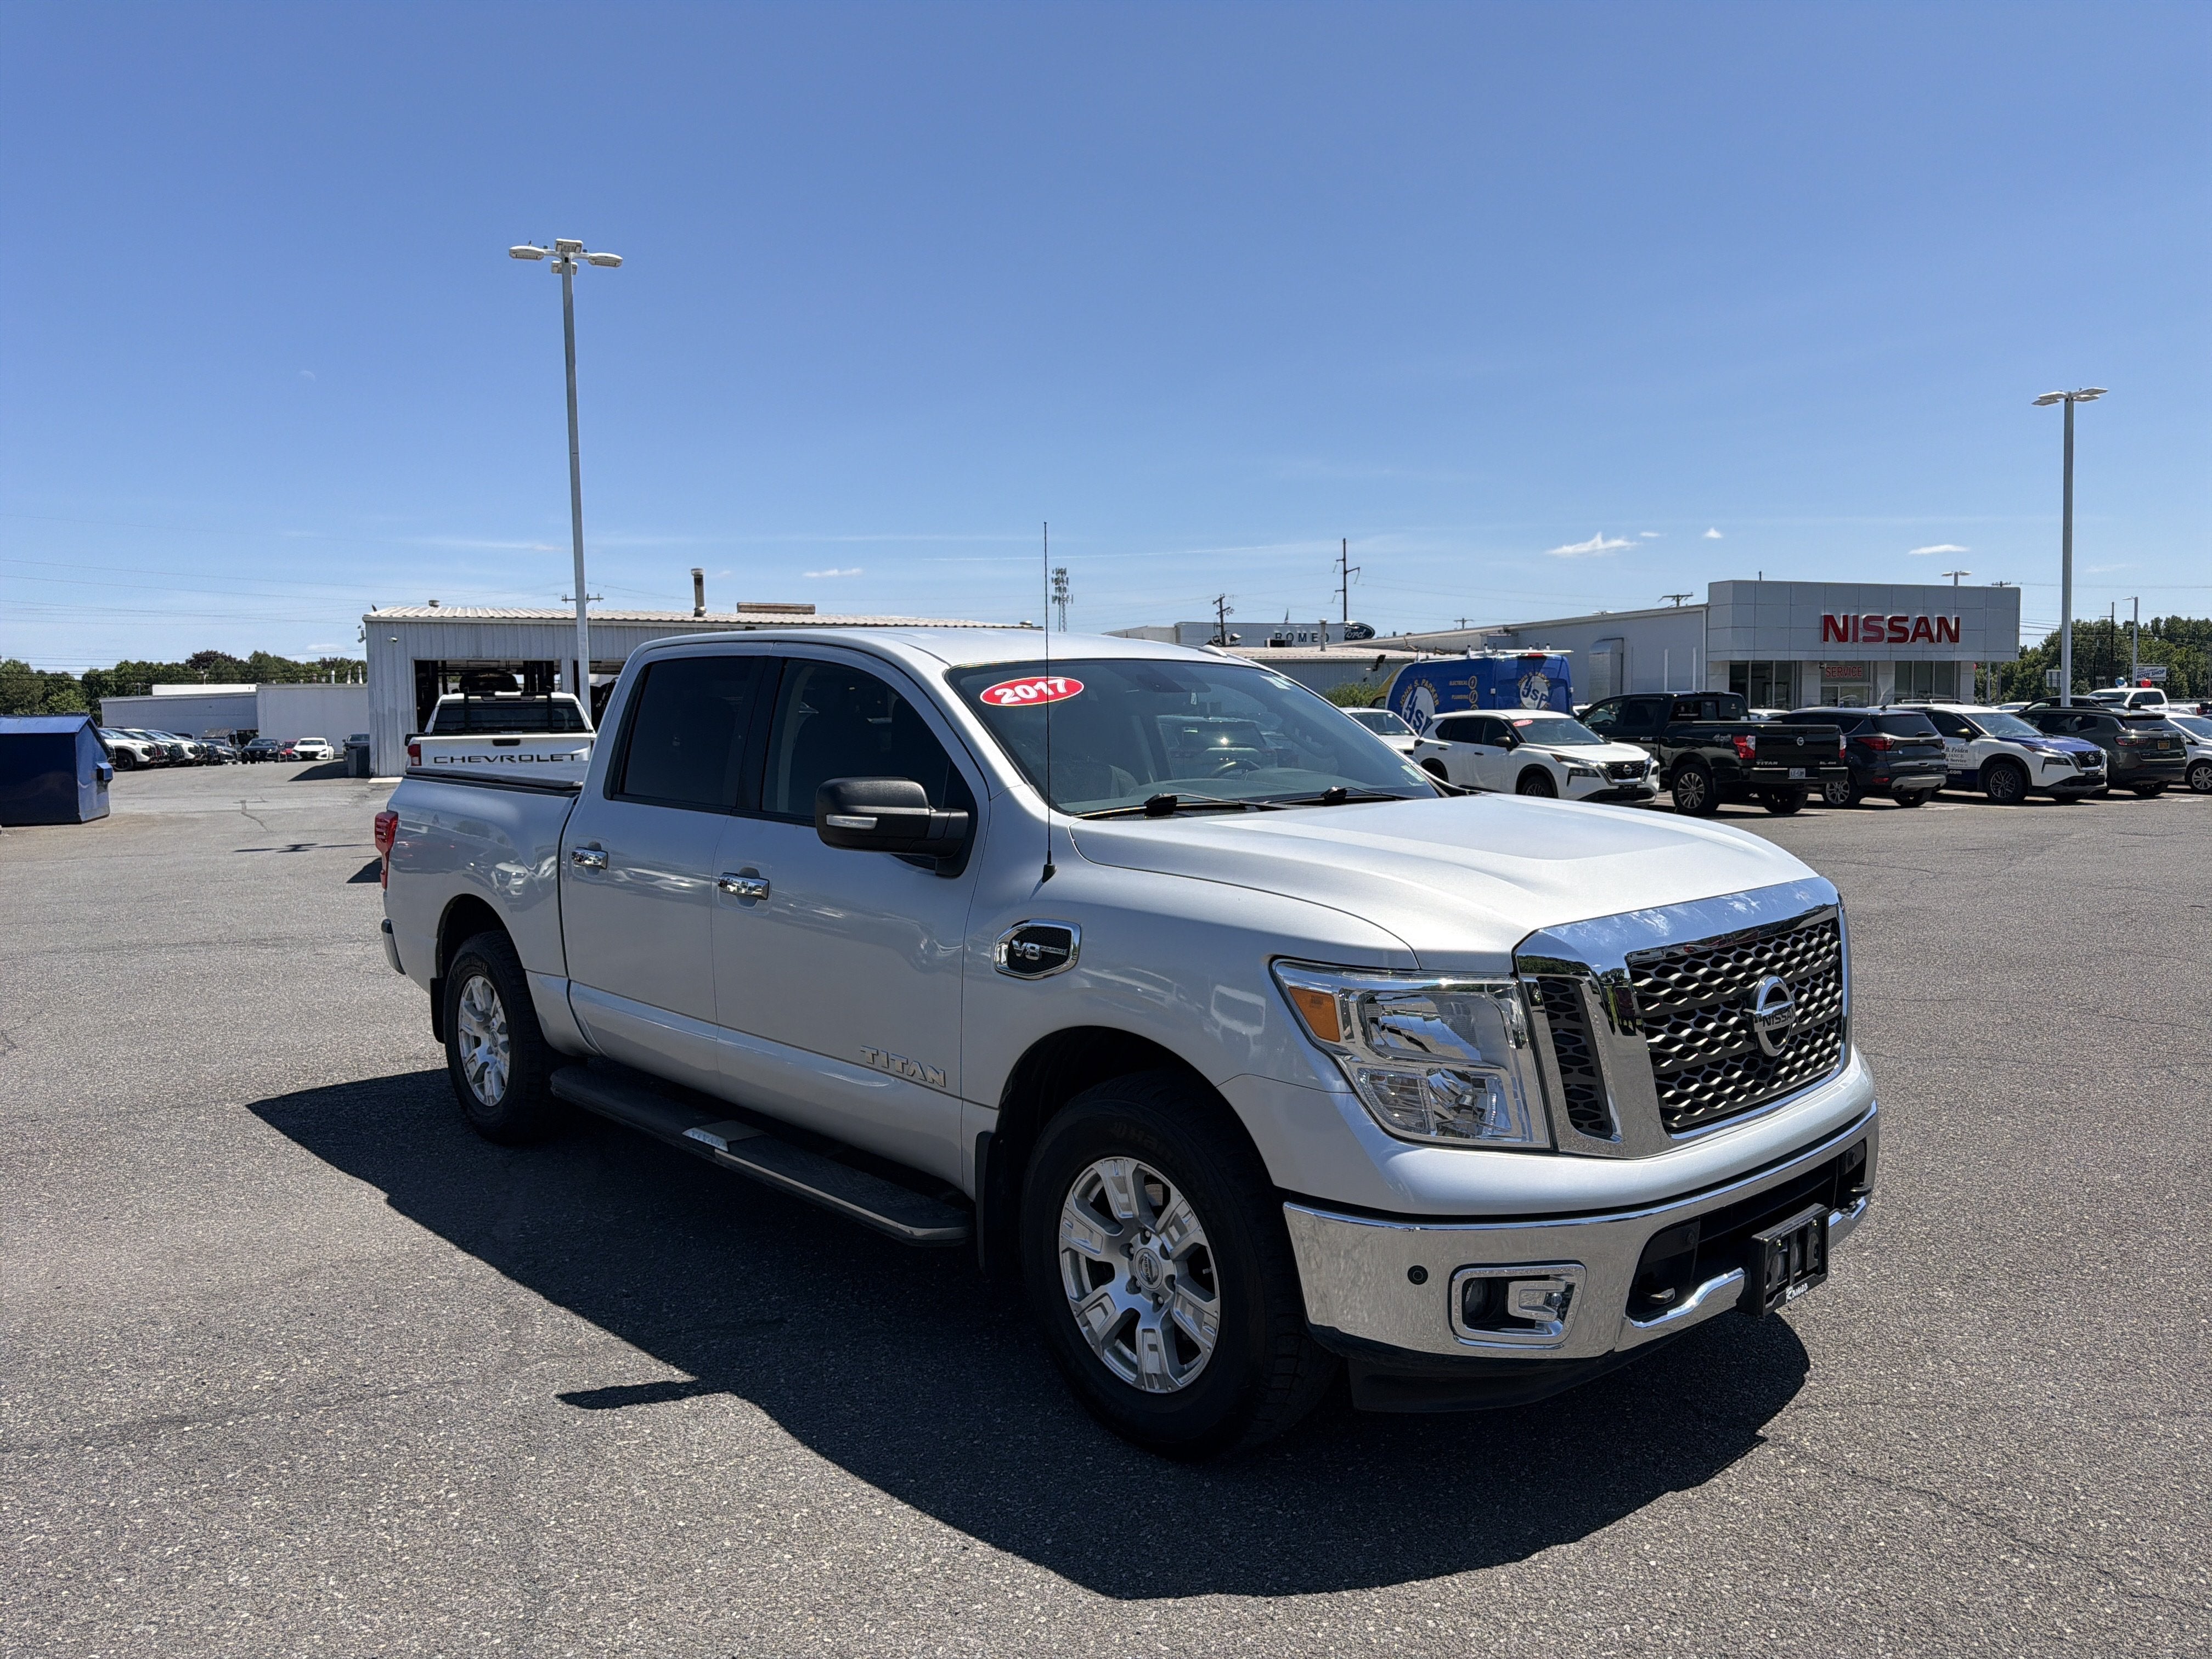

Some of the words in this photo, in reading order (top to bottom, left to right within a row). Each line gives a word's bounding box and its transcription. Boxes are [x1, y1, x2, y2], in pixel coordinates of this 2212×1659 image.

[1823, 614, 1960, 642] NISSAN
[1826, 666, 1863, 678] SERVICE
[994, 679, 1068, 704] 2017
[1400, 684, 1413, 707] JOHN
[1421, 679, 1440, 707] PARKER
[433, 753, 580, 764] CHEVROLET
[1012, 939, 1041, 961] V8
[1040, 945, 1066, 955] ENDURANCE
[1762, 1006, 1796, 1028] NISSAN
[860, 1045, 946, 1088] TITAN
